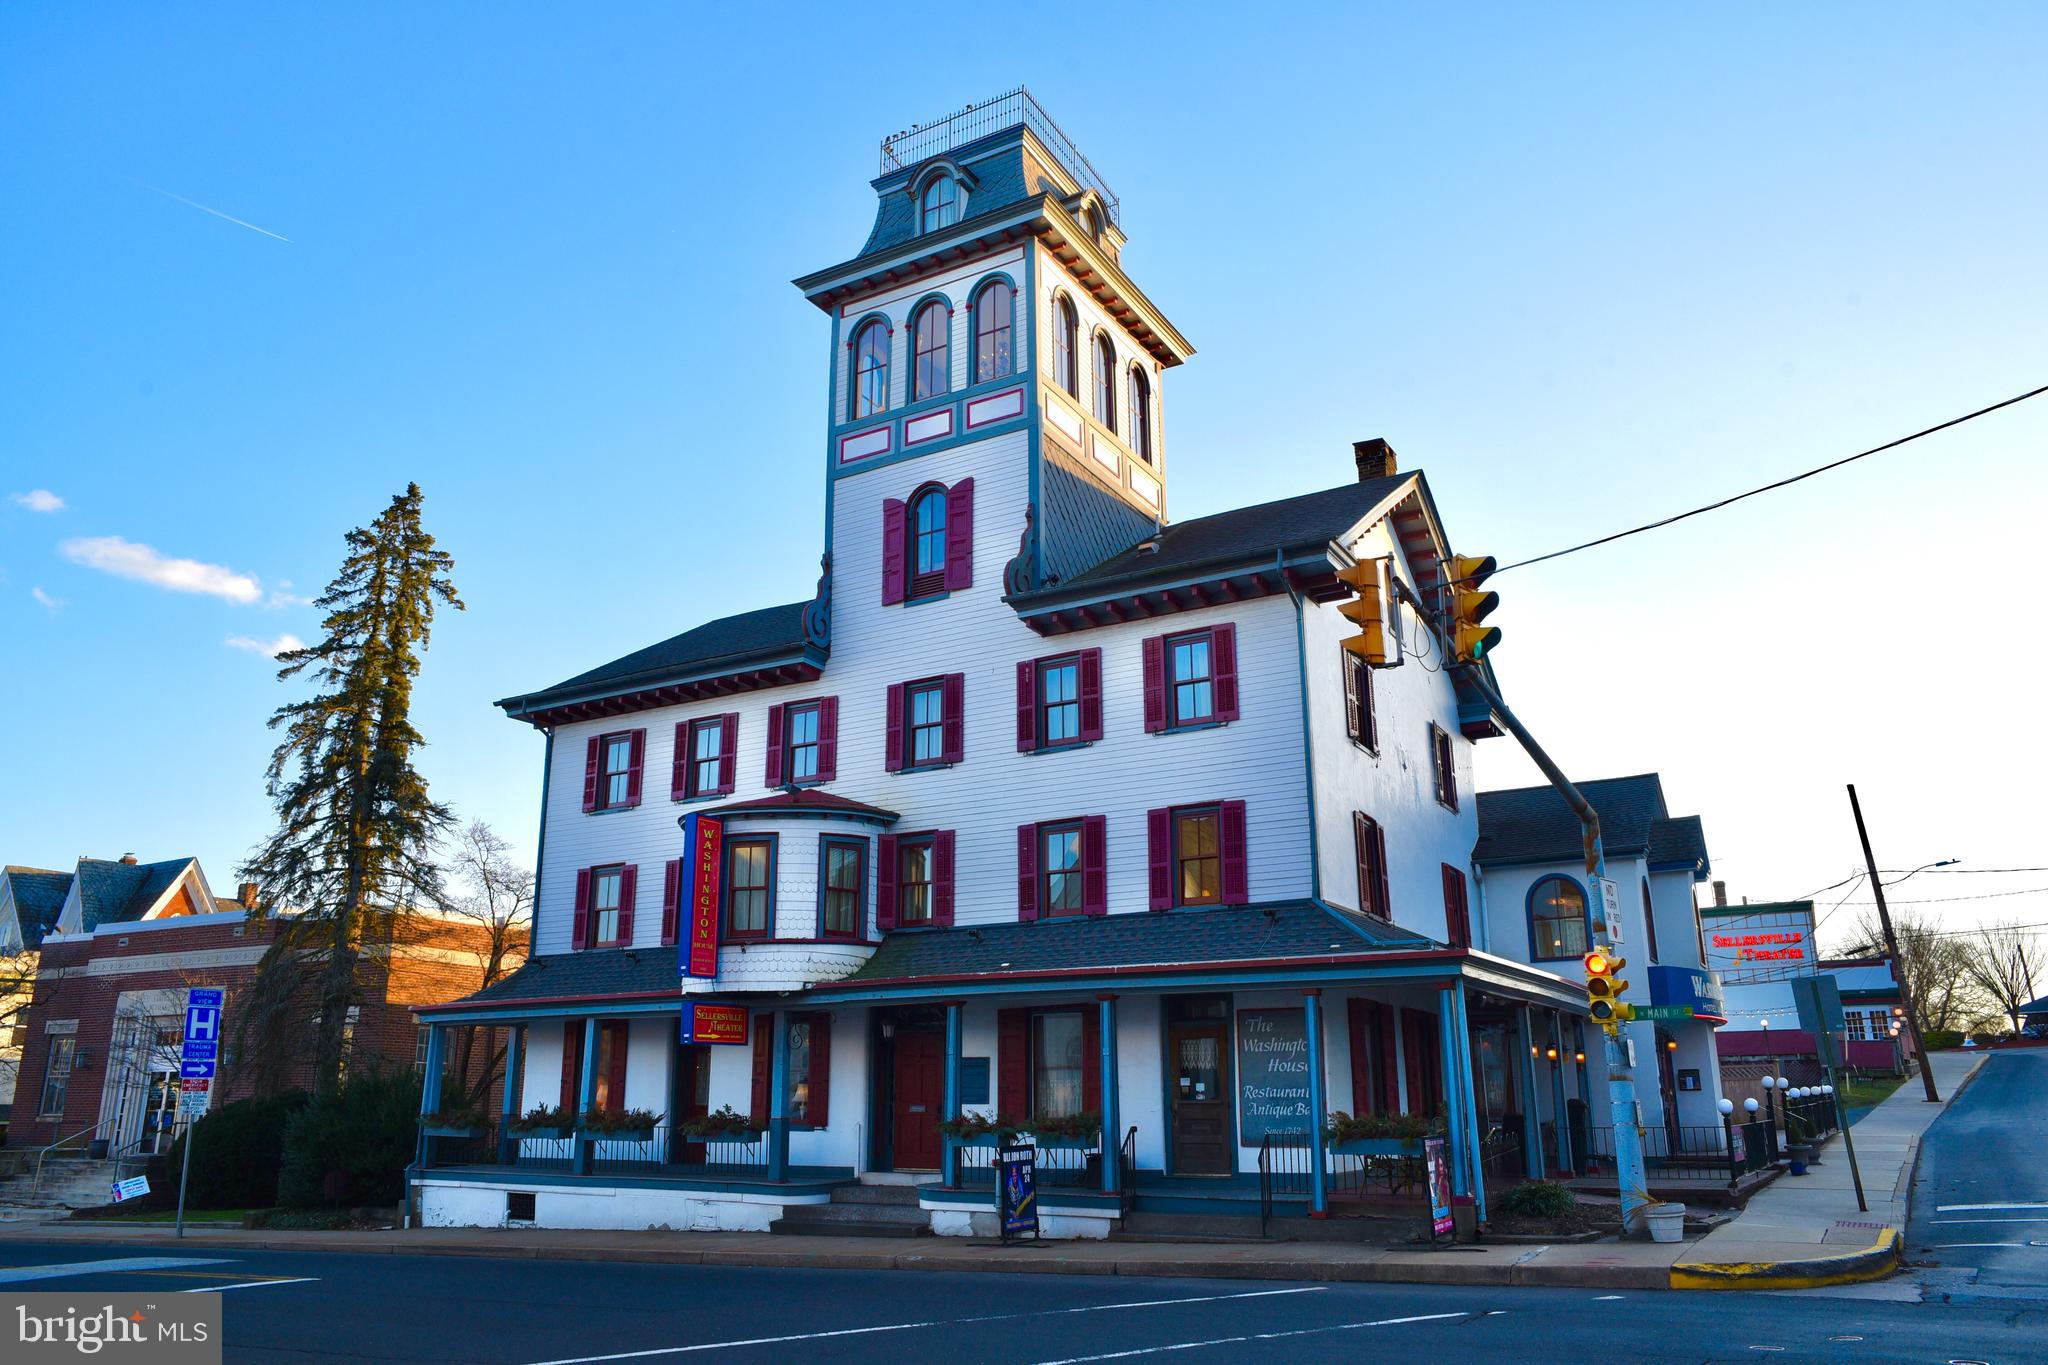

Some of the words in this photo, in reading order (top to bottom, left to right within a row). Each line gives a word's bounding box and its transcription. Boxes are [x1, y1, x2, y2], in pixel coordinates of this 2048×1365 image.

[700, 829, 714, 939] WASHINGTON
[1606, 884, 1613, 896] NO
[1606, 899, 1617, 910] TURN
[693, 942, 714, 950] HOUSE
[1712, 932, 1802, 948] SELLERSVILLE
[1743, 948, 1804, 961] THEATER
[696, 1009, 743, 1021] SELLERSVILLE
[1647, 1008, 1669, 1019] MAIN
[189, 1009, 215, 1039] H
[713, 1020, 743, 1032] THEATER
[1245, 1016, 1273, 1032] The
[1243, 1037, 1307, 1060] Washingto
[1247, 1102, 1294, 1118] Antique
[1264, 1126, 1284, 1135] Since
[1024, 1174, 1031, 1183] 24
